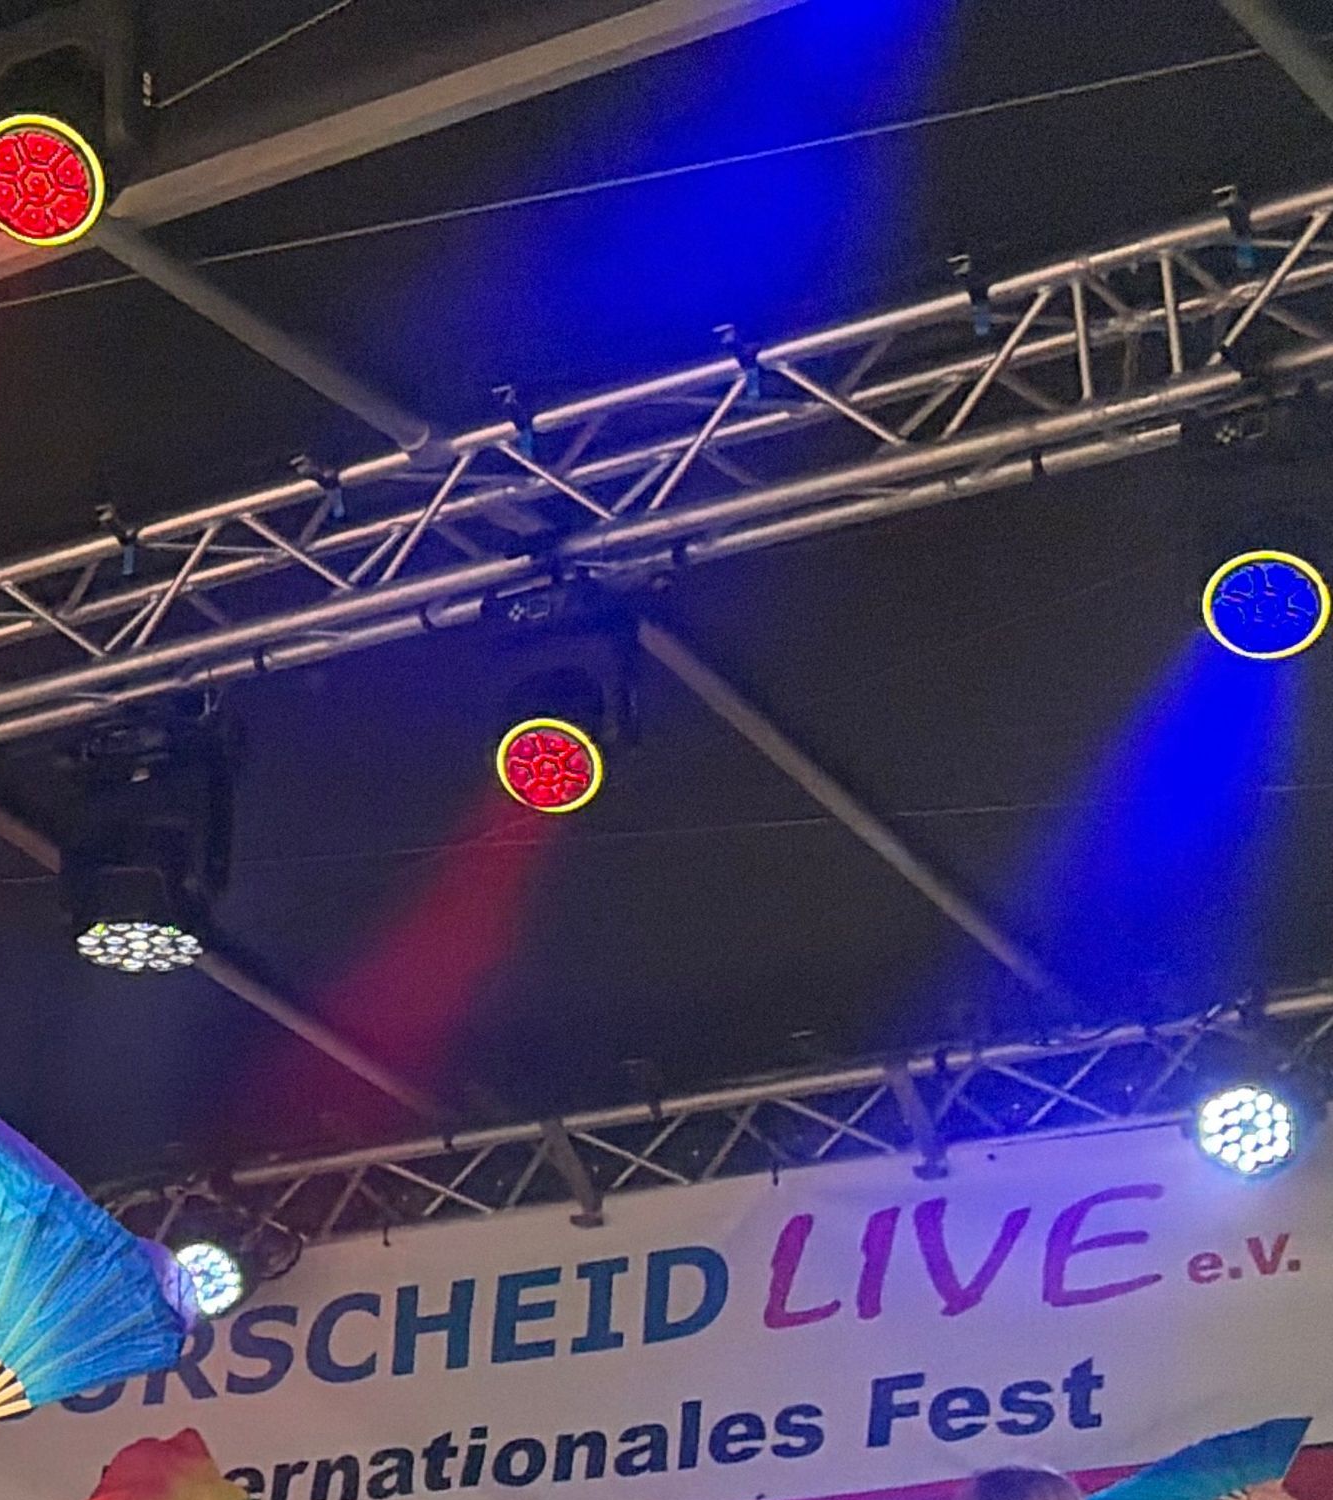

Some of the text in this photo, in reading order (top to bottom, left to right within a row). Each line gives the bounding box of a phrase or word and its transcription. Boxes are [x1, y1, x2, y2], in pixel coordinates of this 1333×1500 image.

[763, 1183, 1164, 1329] LIVE
[1187, 1232, 1301, 1285] e.V.
[866, 1357, 1105, 1448] Fest
